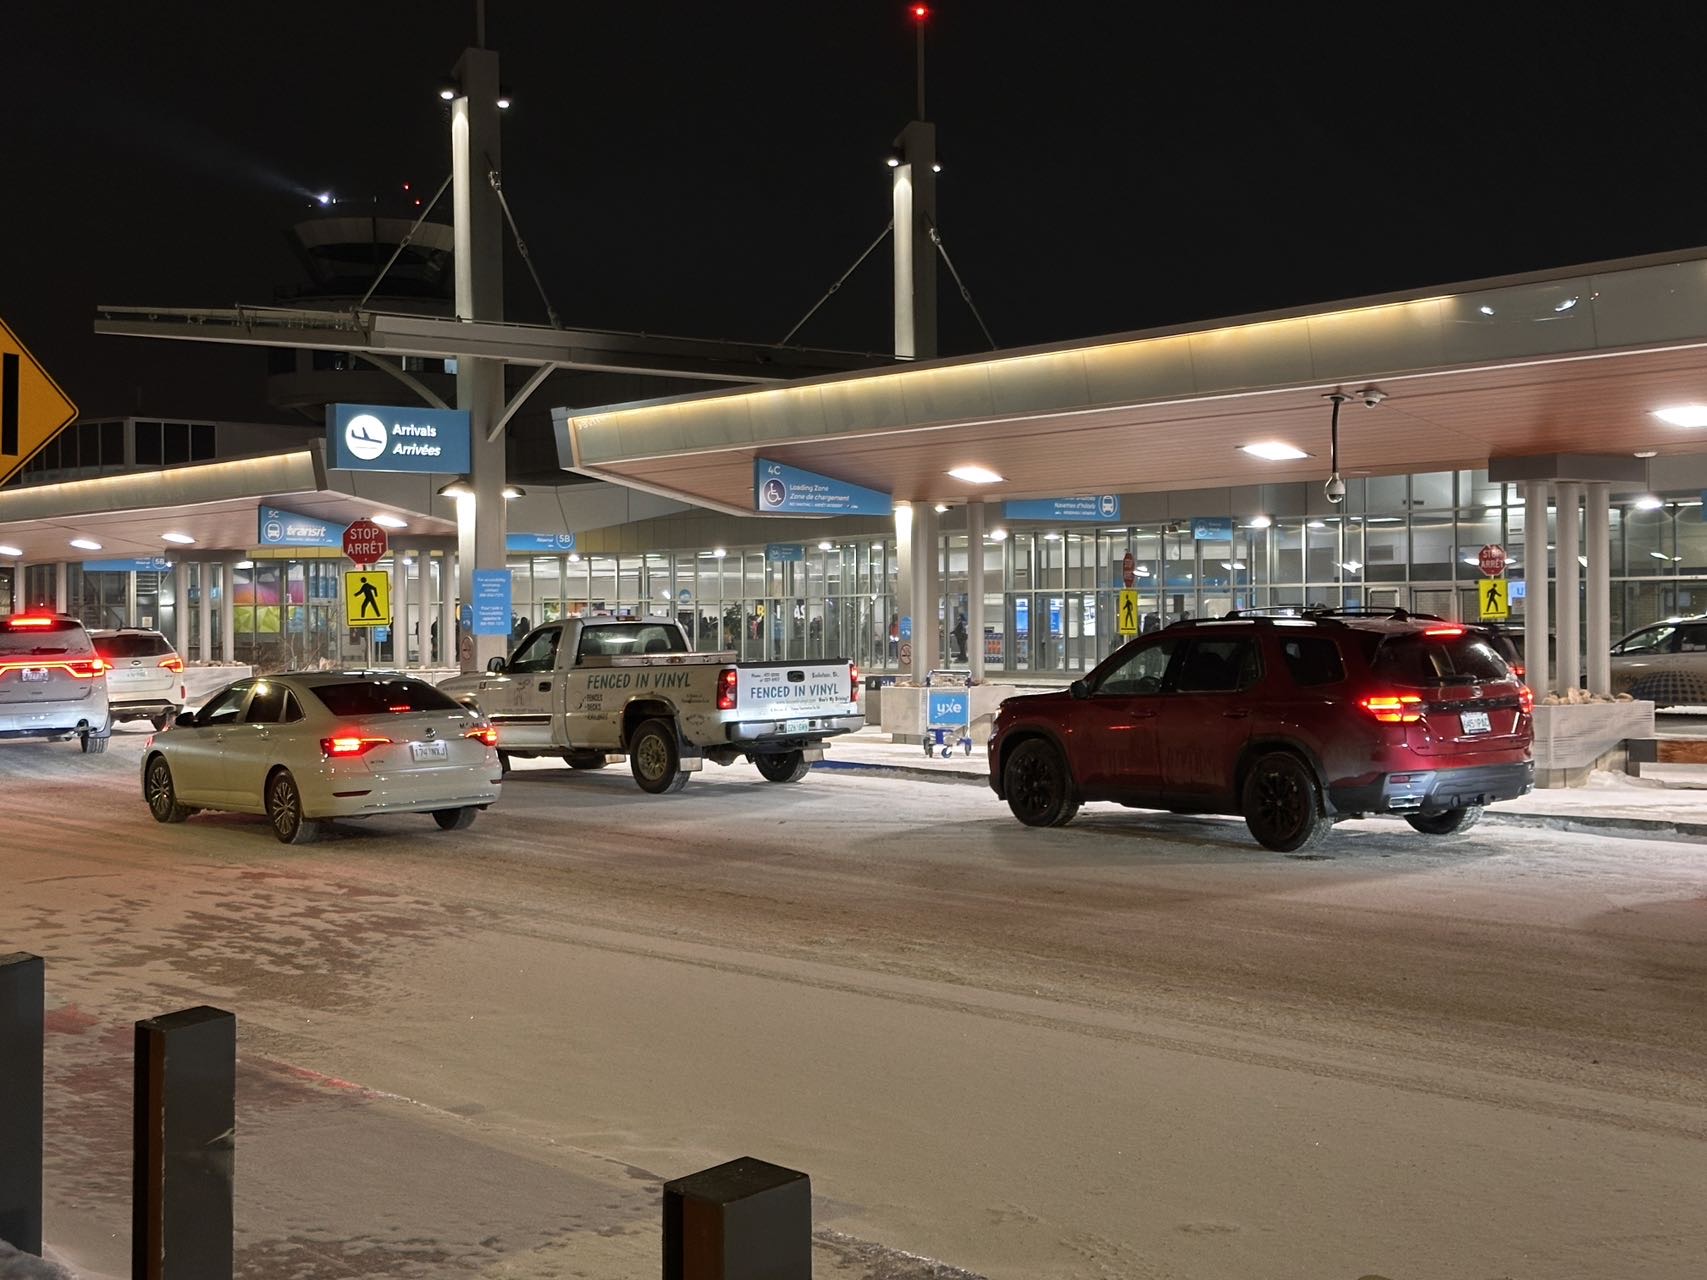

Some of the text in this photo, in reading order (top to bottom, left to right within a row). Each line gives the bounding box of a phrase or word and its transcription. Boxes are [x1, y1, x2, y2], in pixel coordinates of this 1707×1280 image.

[392, 423, 437, 437] Arrivals
[392, 443, 441, 457] Arrivées
[768, 466, 781, 475] 4C
[790, 484, 829, 493] Loading Zone
[814, 493, 850, 502] chargement
[286, 525, 326, 537] transit
[350, 527, 379, 540] STOP
[347, 541, 384, 555] ARRÊT
[1483, 549, 1504, 558] STOP
[587, 671, 691, 689] FENCED IN VINYL
[750, 683, 839, 699] FENCED IN VINYL
[936, 698, 962, 719] uxe
